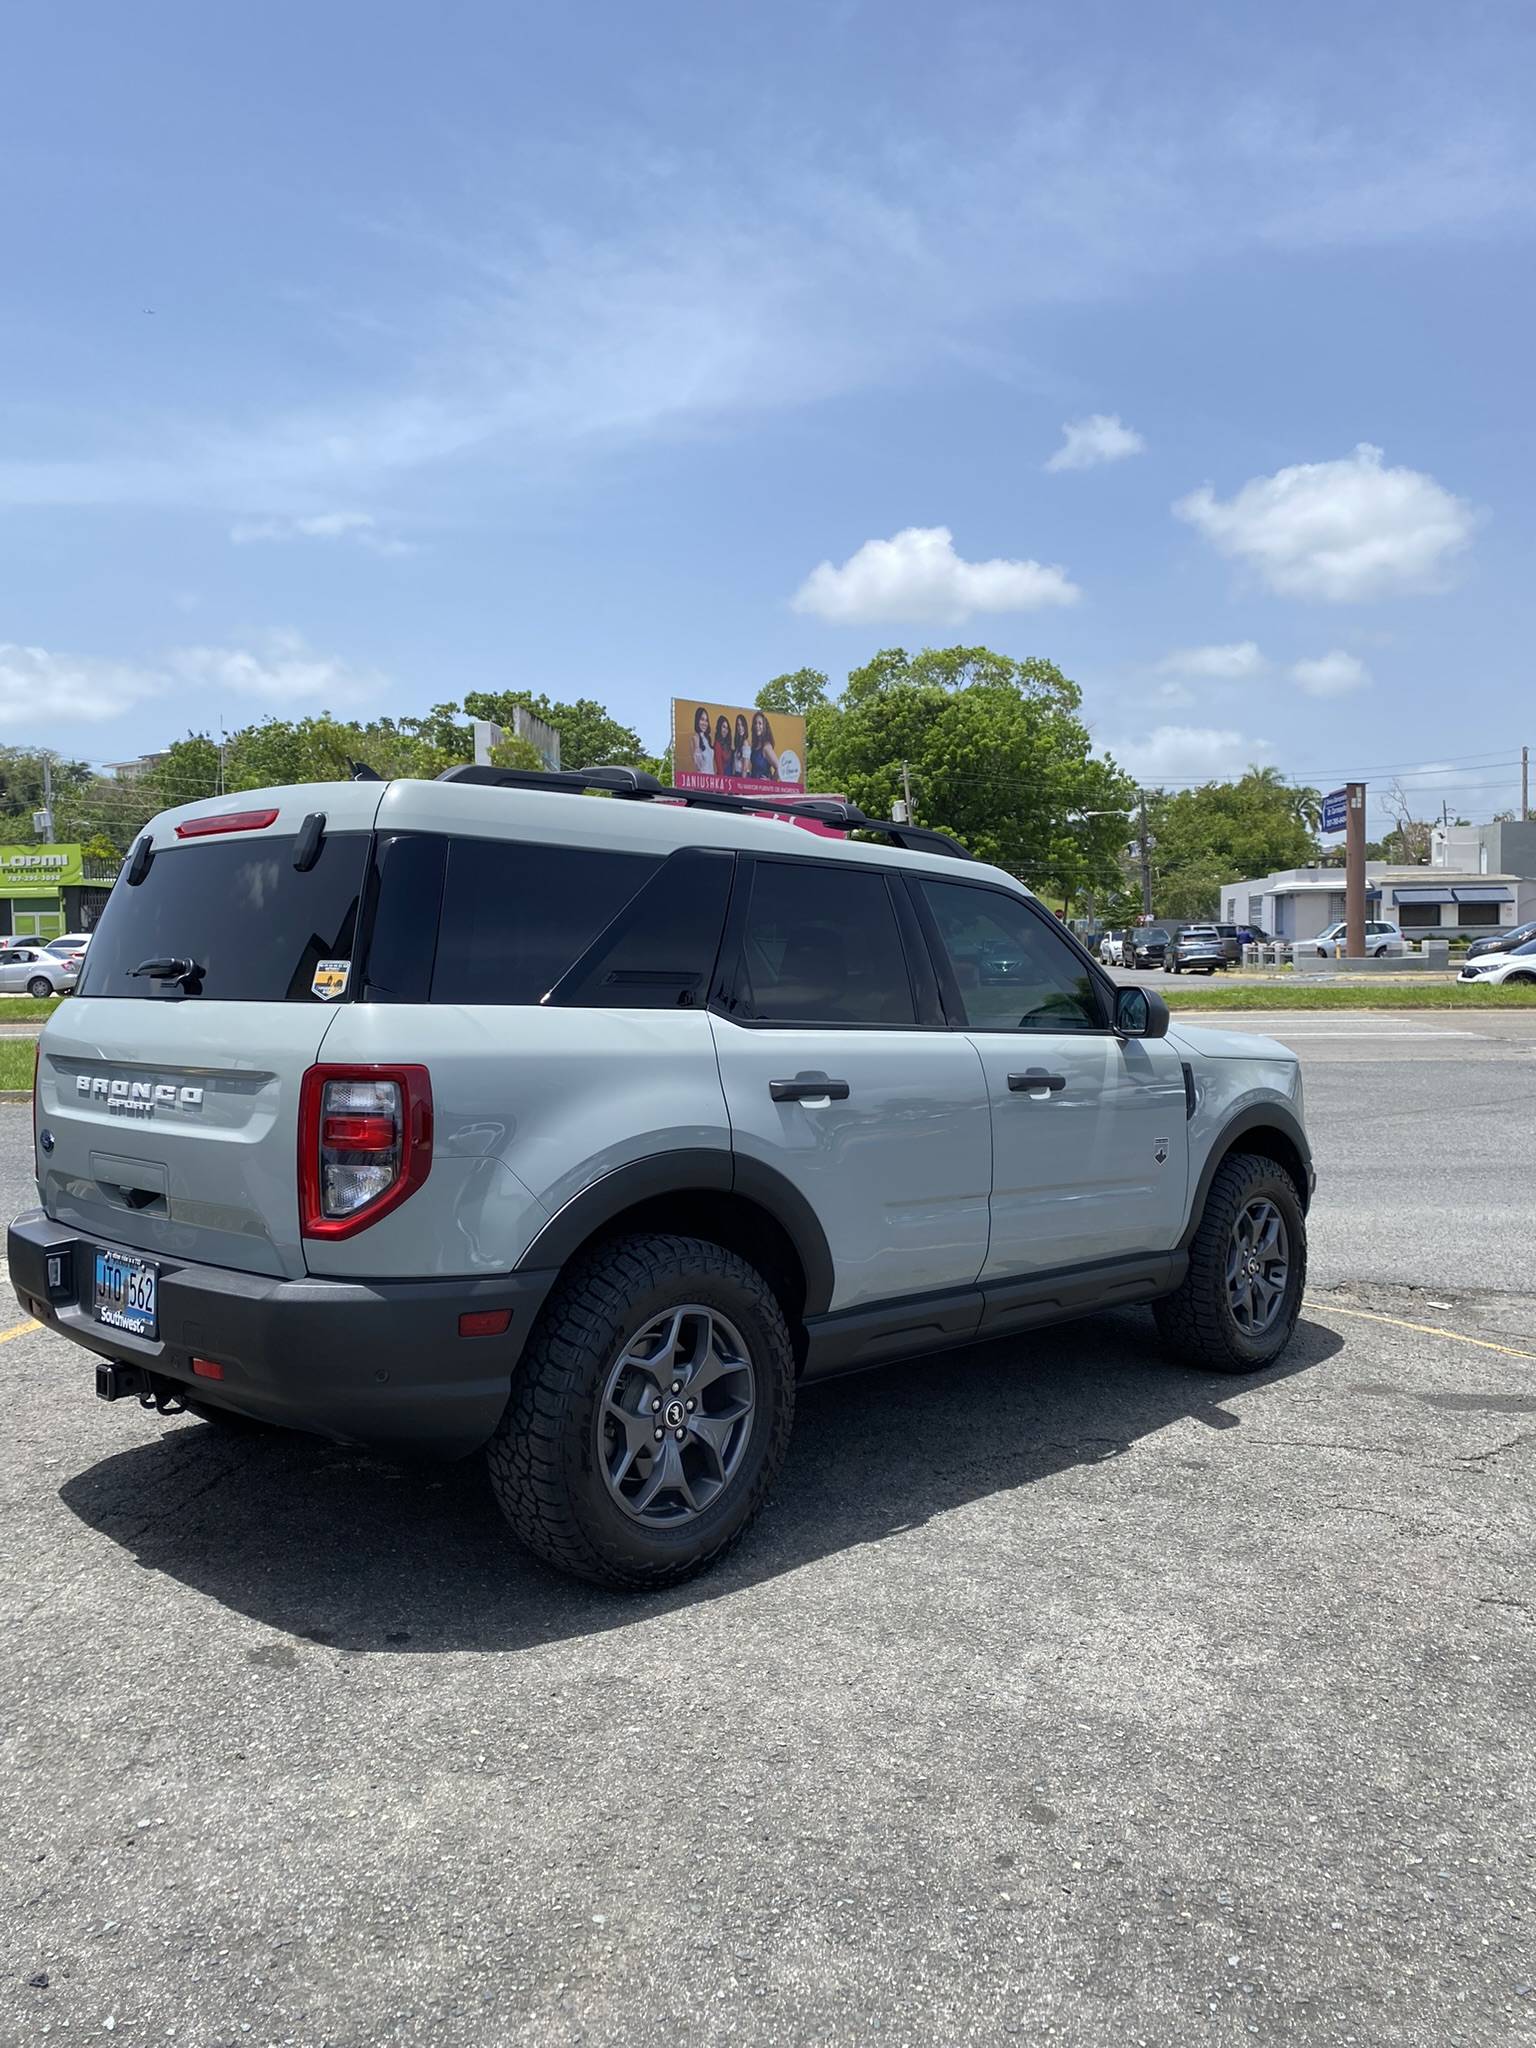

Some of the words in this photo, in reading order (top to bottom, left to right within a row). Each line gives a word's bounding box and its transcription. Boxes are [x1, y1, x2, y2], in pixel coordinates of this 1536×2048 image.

[681, 774, 732, 791] JANIUSHKA'S
[76, 1075, 203, 1103] BRONCO
[107, 1098, 155, 1110] SPORT
[129, 1273, 153, 1312] 562
[101, 1306, 142, 1333] Southwest
